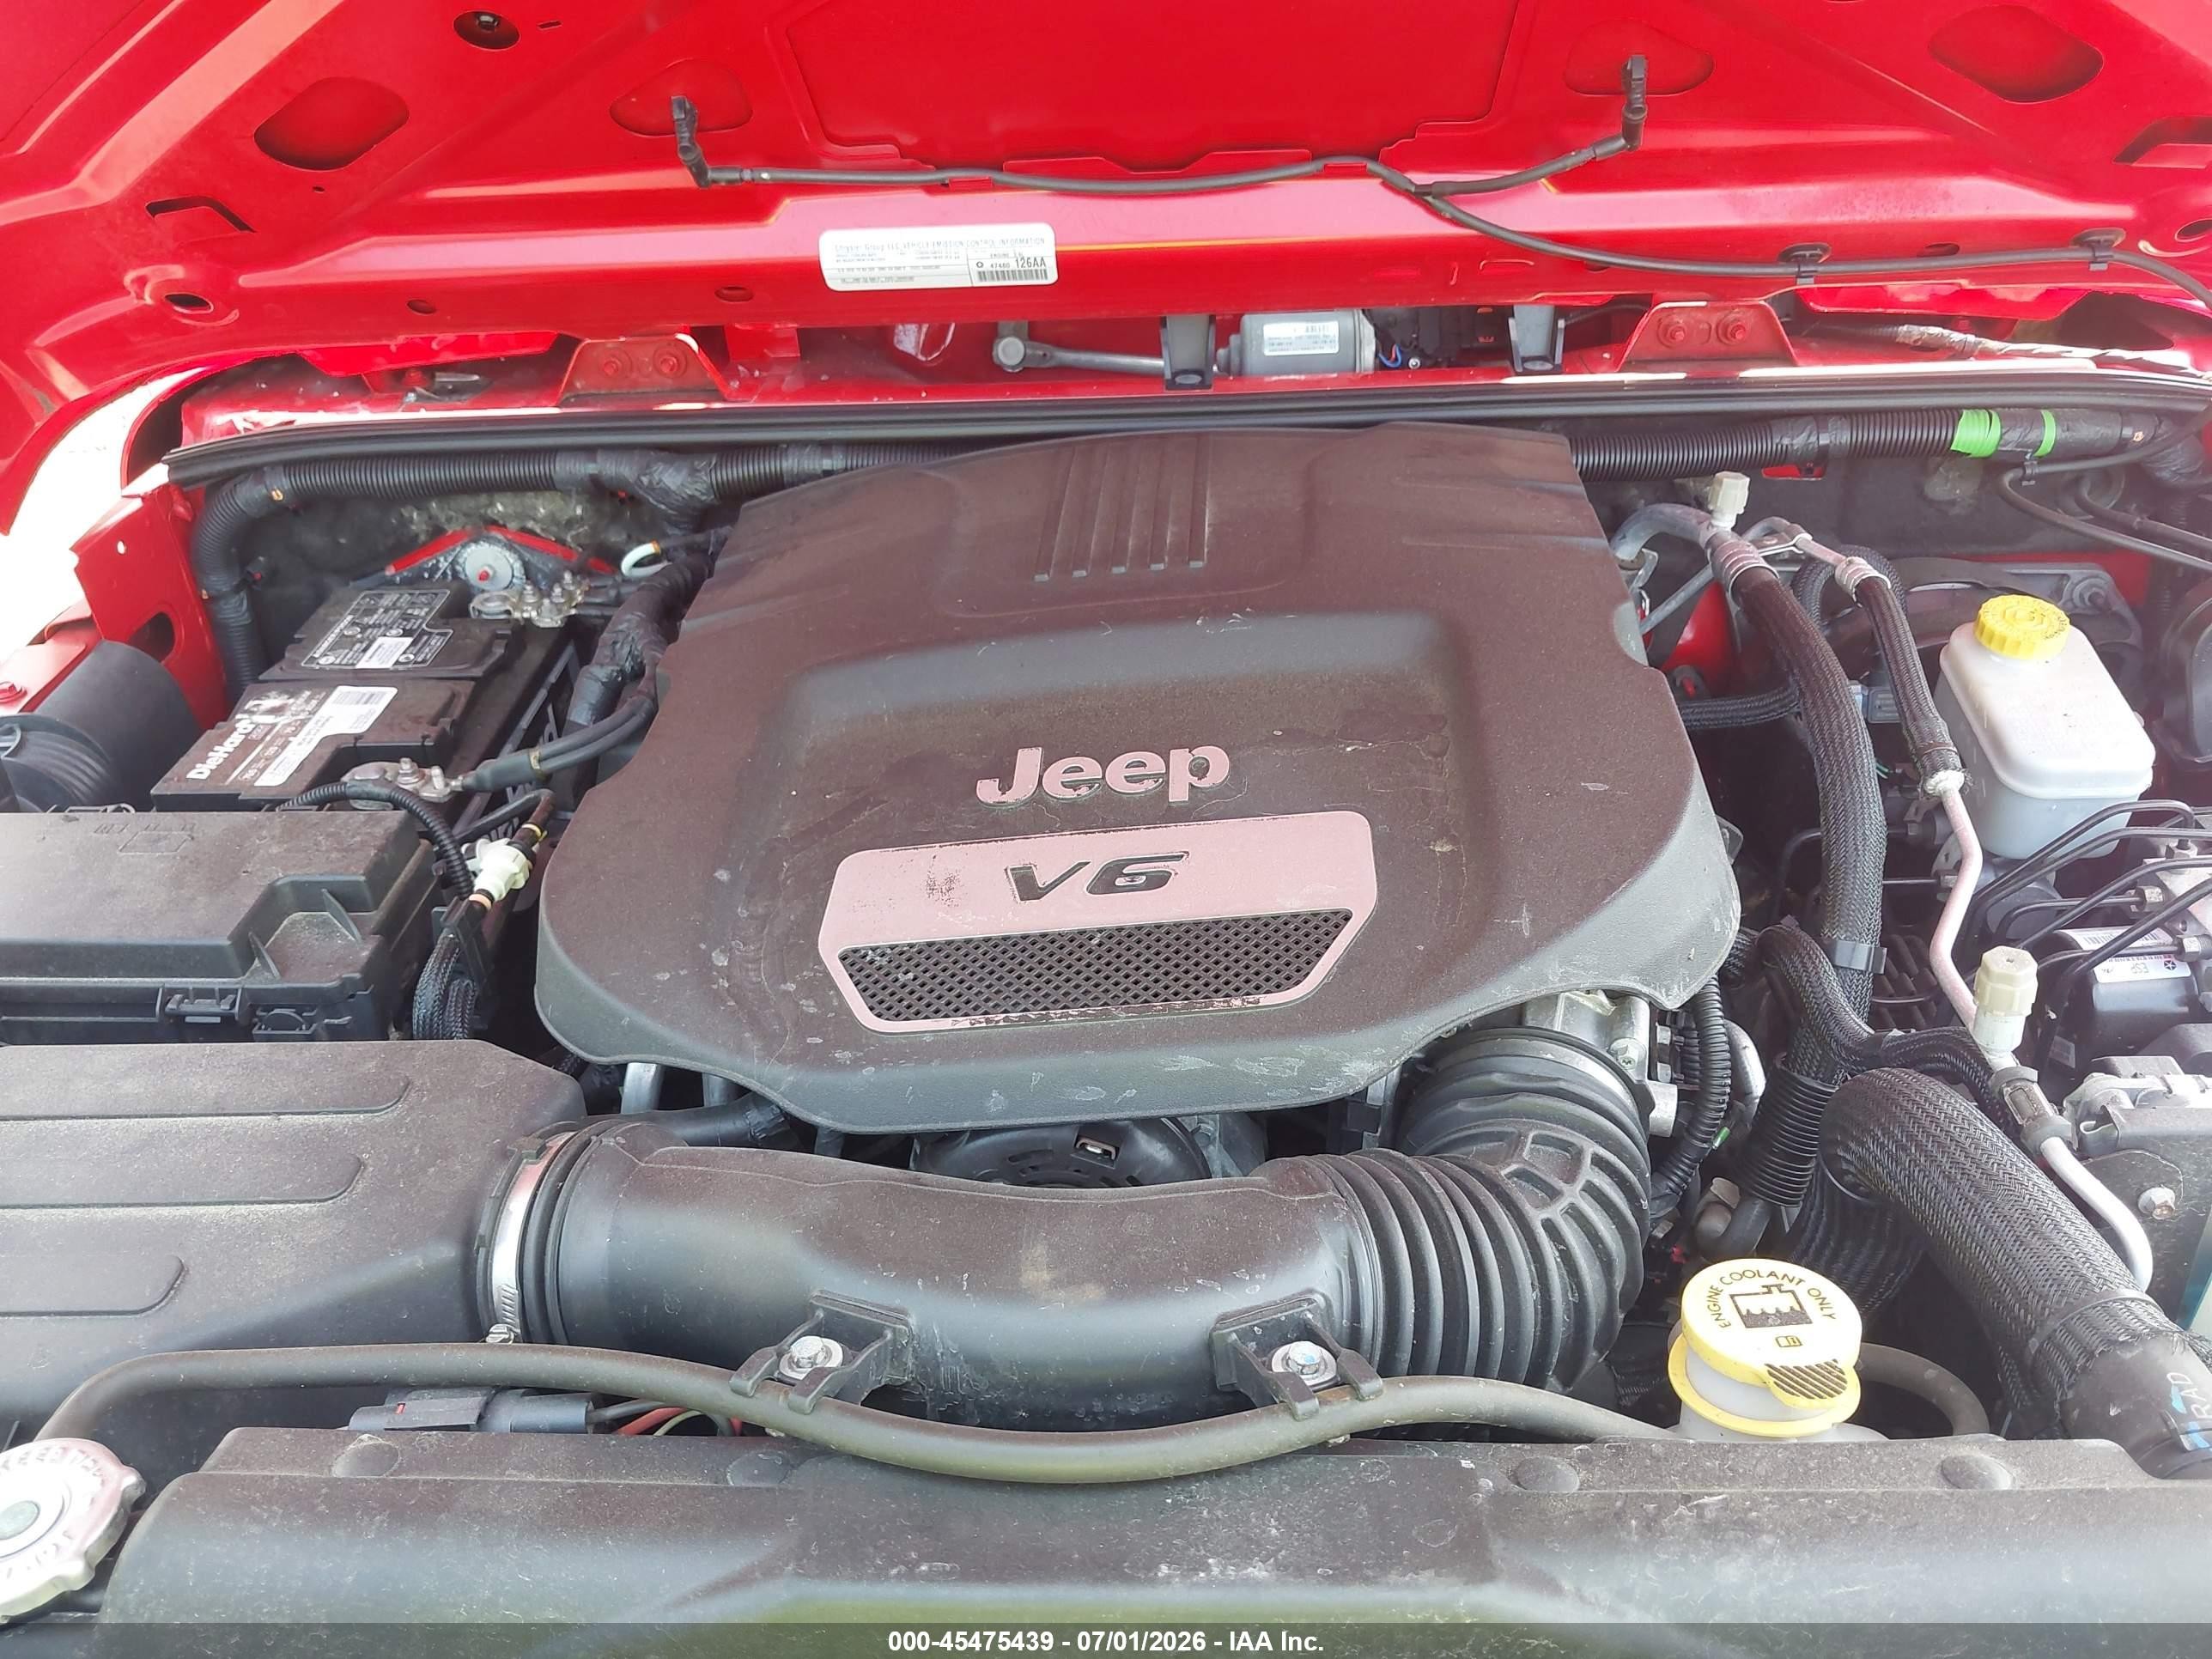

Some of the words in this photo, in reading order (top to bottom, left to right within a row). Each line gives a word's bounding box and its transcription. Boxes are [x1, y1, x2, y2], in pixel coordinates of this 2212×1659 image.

[999, 237, 1045, 246] INFORMATION
[1015, 256, 1047, 269] 126AA
[185, 714, 256, 780] DieHard
[976, 744, 1231, 805] Jeep
[1005, 851, 1190, 903] V6
[1719, 1269, 1806, 1286] COOLANT
[1707, 1285, 1732, 1328] ENGINE
[1807, 1287, 1838, 1321] ONLY
